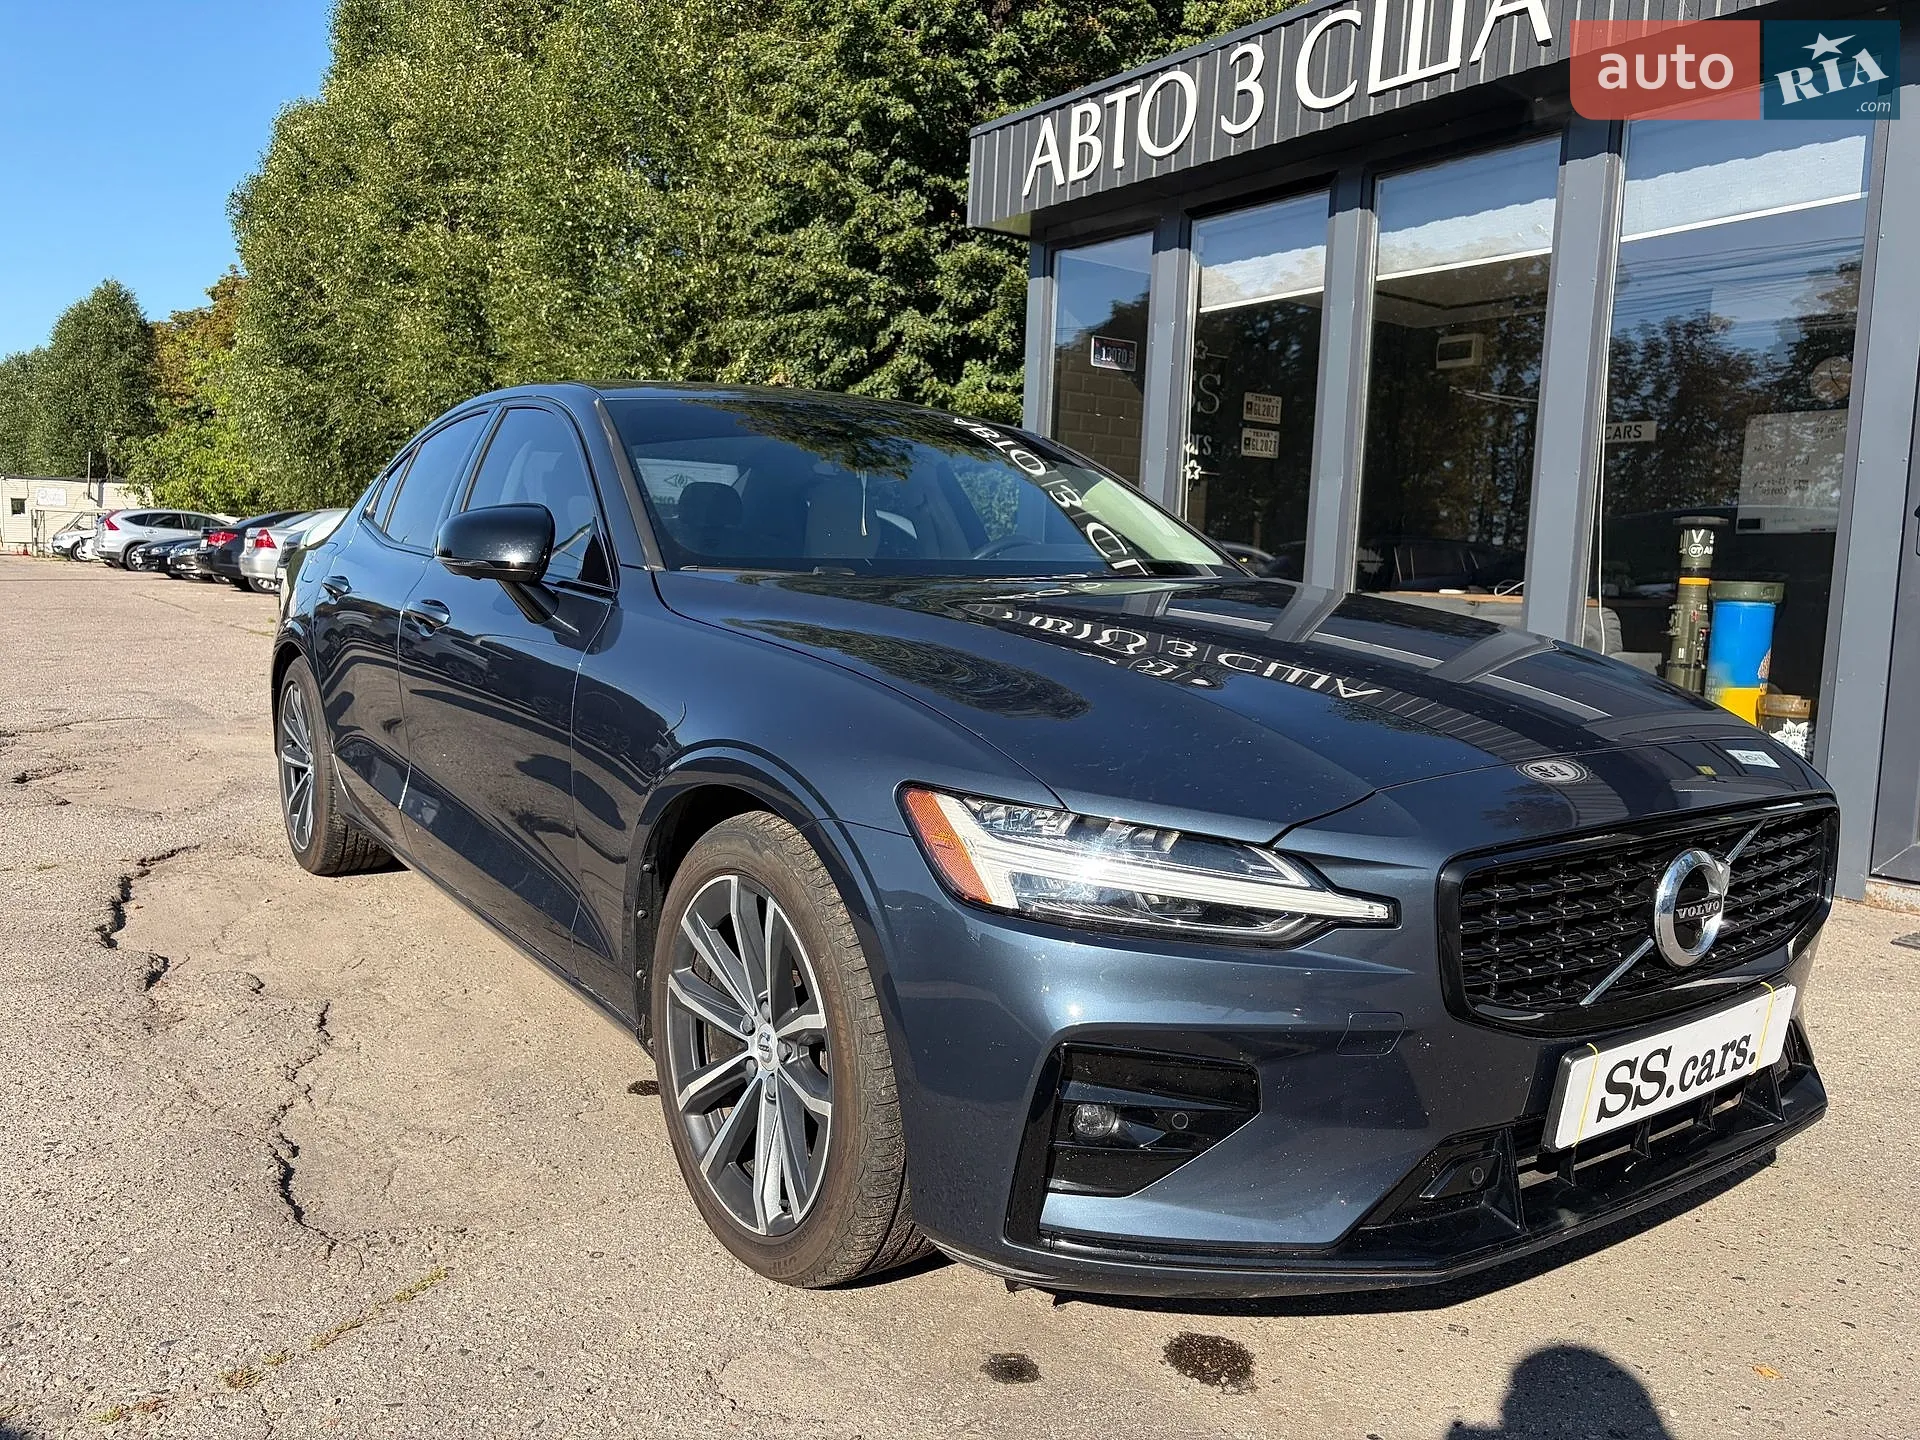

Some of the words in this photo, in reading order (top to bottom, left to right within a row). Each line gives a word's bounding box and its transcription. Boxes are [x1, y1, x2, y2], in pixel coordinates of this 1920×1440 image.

[1022, 69, 1197, 197] АВТО
[1221, 42, 1265, 136] З
[1295, 0, 1553, 110] США
[1675, 900, 1720, 919] VOLVO
[1595, 1033, 1757, 1123] SS.cars.
